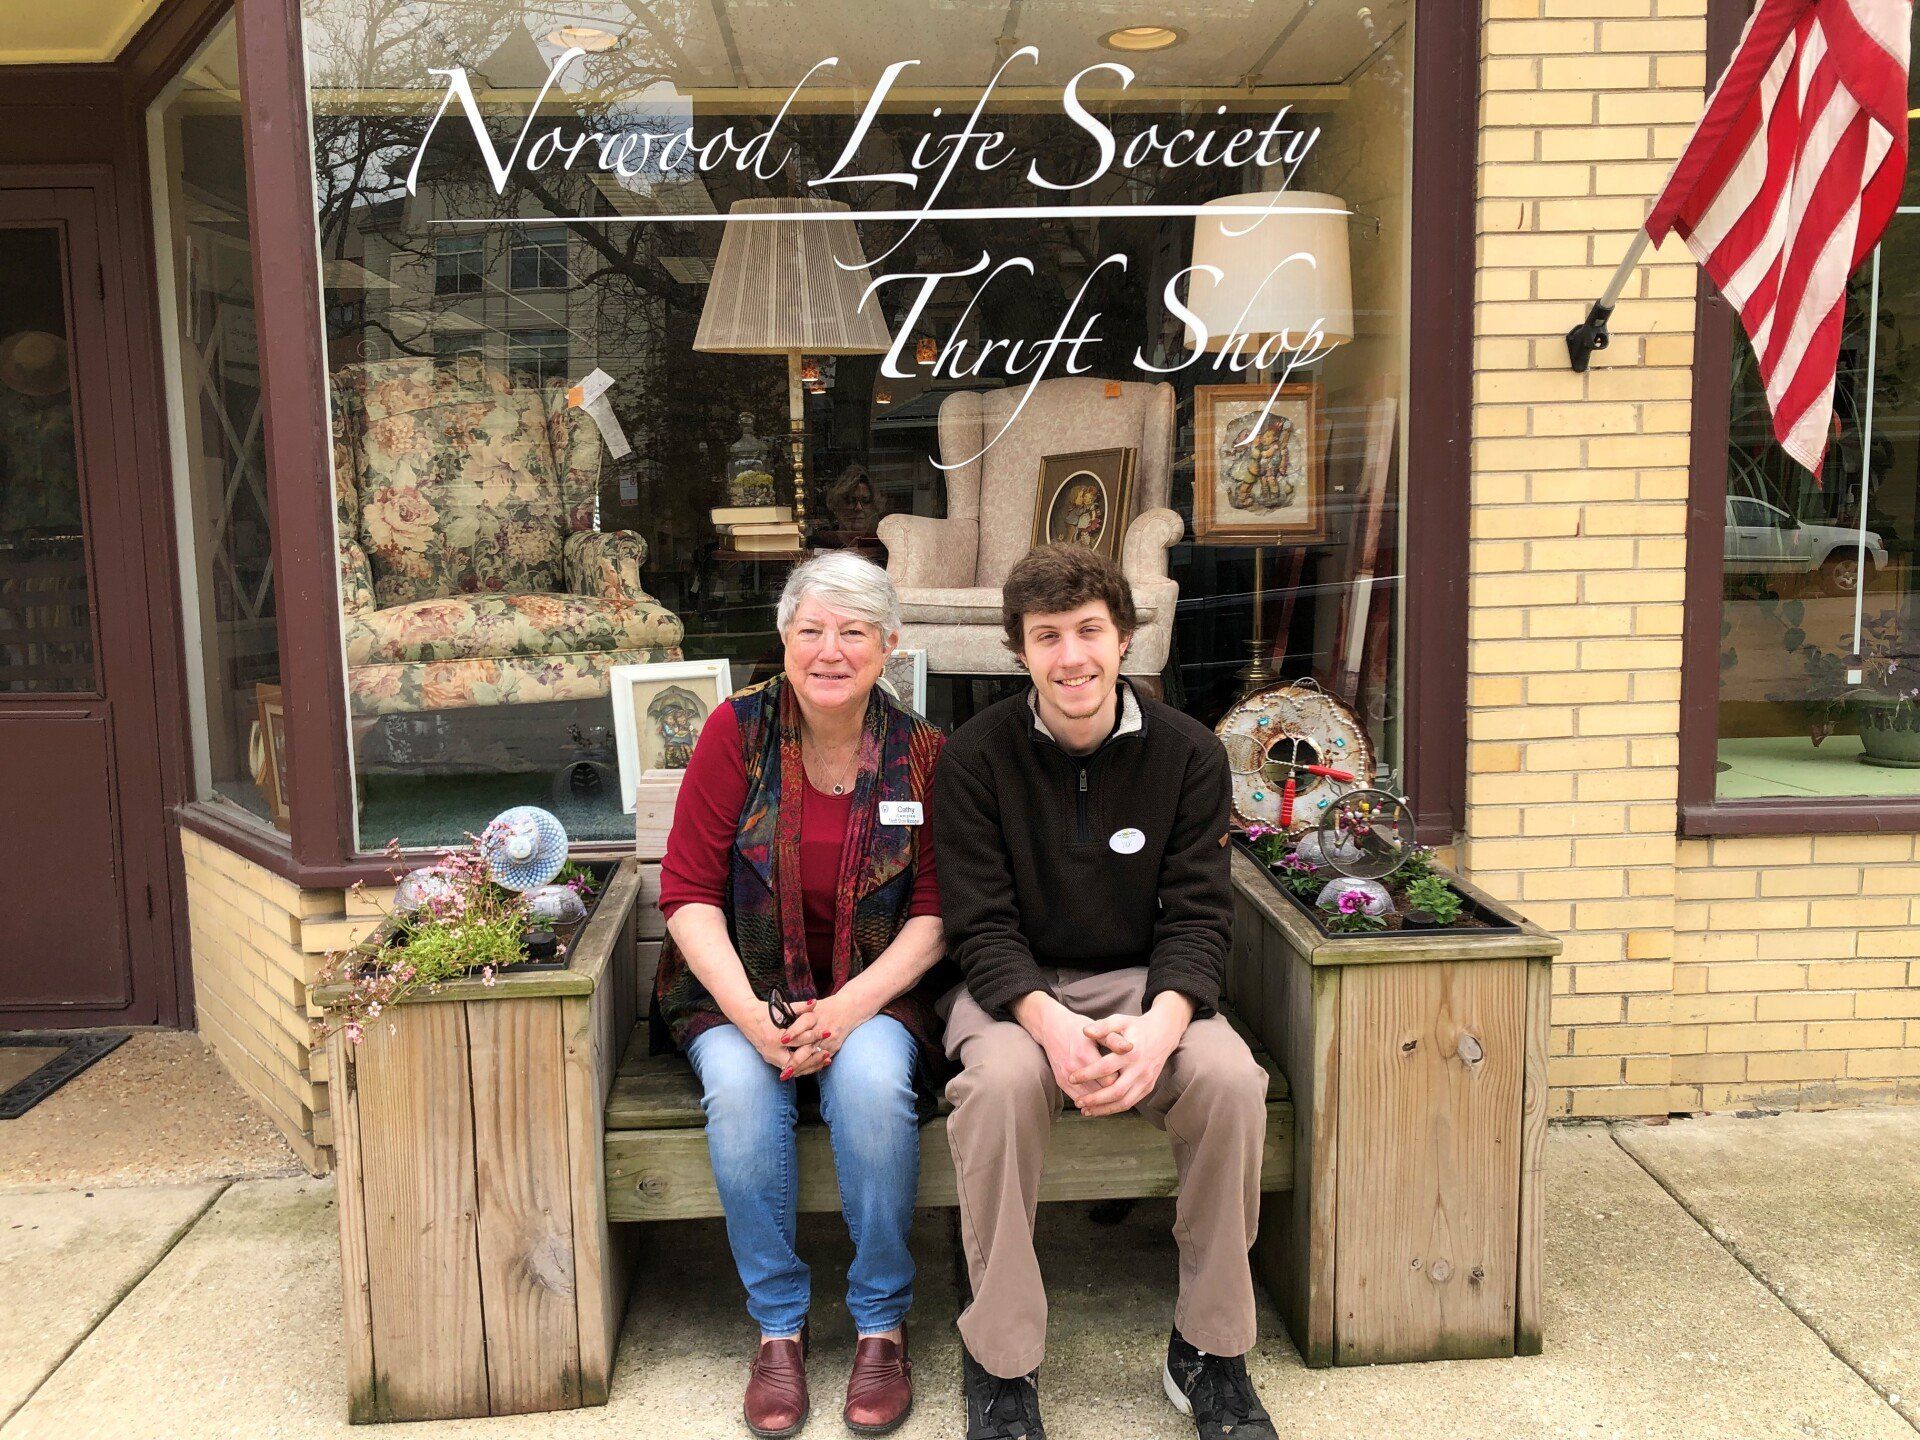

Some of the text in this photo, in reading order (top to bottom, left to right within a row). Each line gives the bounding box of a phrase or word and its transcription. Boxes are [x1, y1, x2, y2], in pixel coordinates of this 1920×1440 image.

[406, 45, 1321, 271] Norwood Life Society
[857, 250, 1341, 470] Thrift Shop
